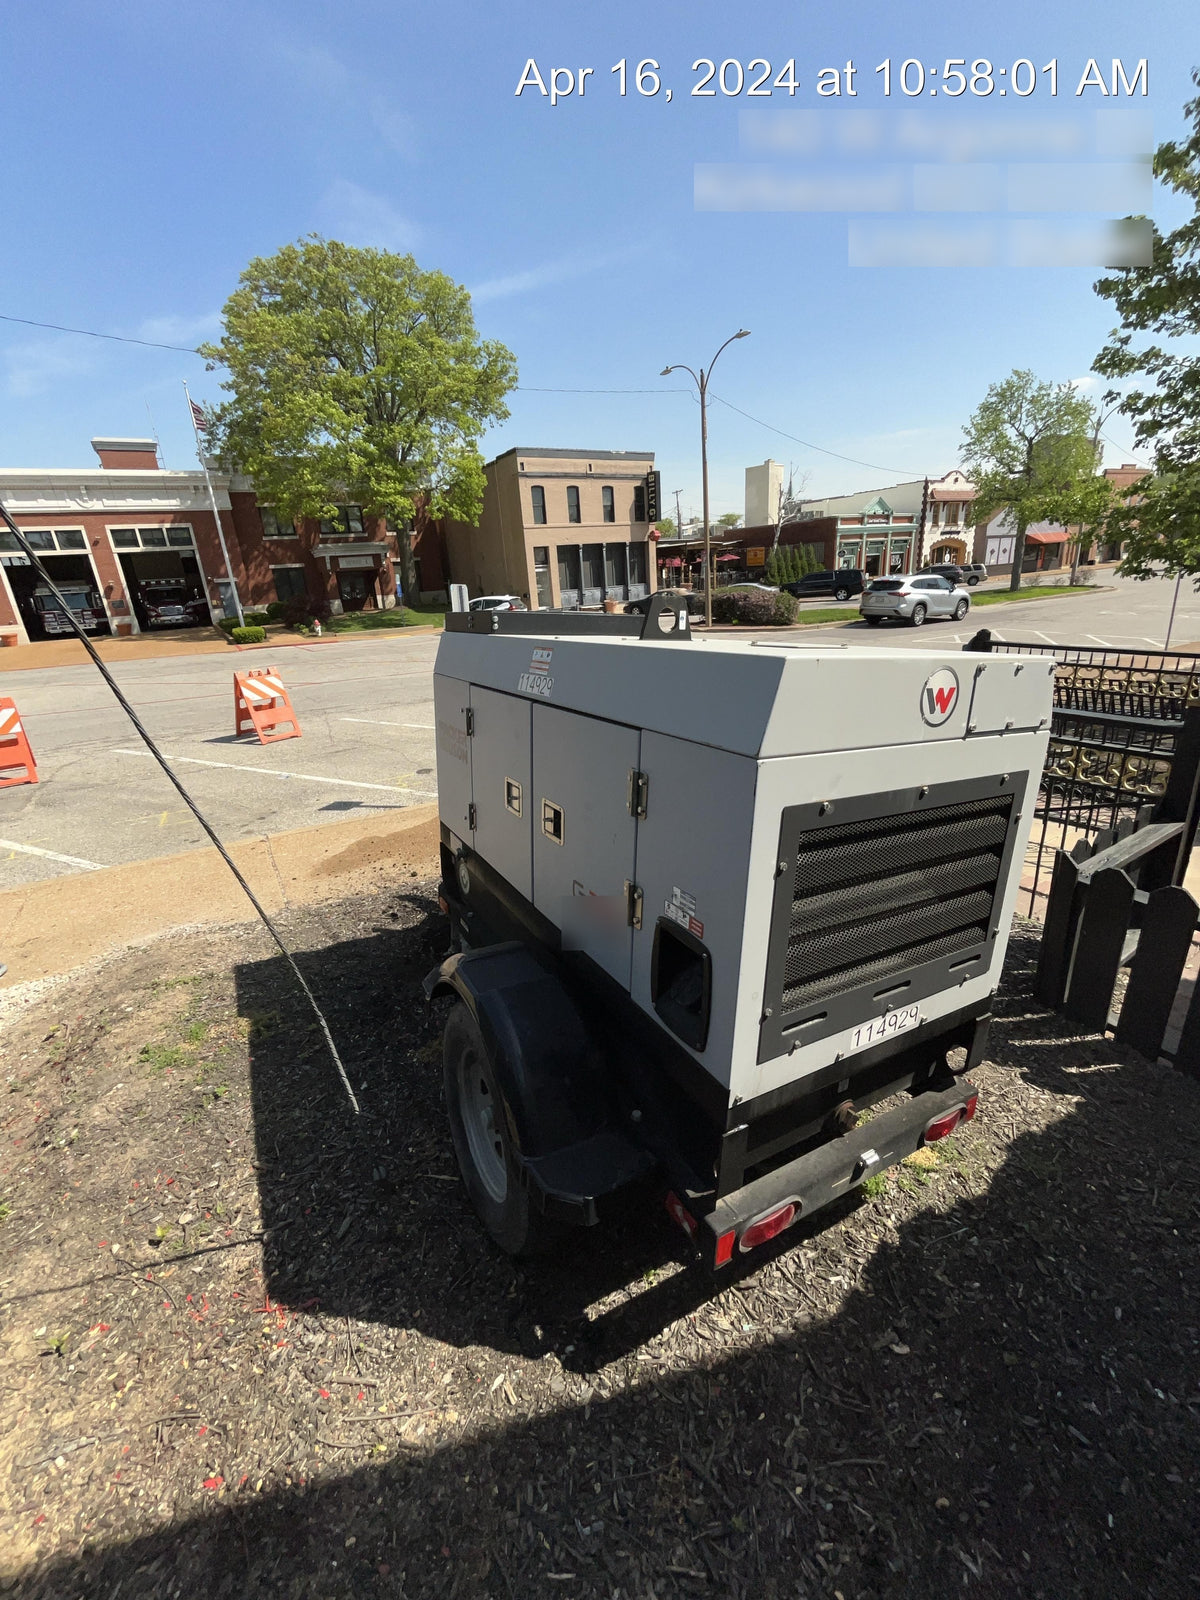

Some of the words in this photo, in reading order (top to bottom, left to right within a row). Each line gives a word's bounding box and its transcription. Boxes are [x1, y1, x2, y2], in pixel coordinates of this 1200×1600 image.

[520, 674, 554, 696] 114929
[926, 686, 956, 714] W
[854, 1006, 919, 1047] 114929
